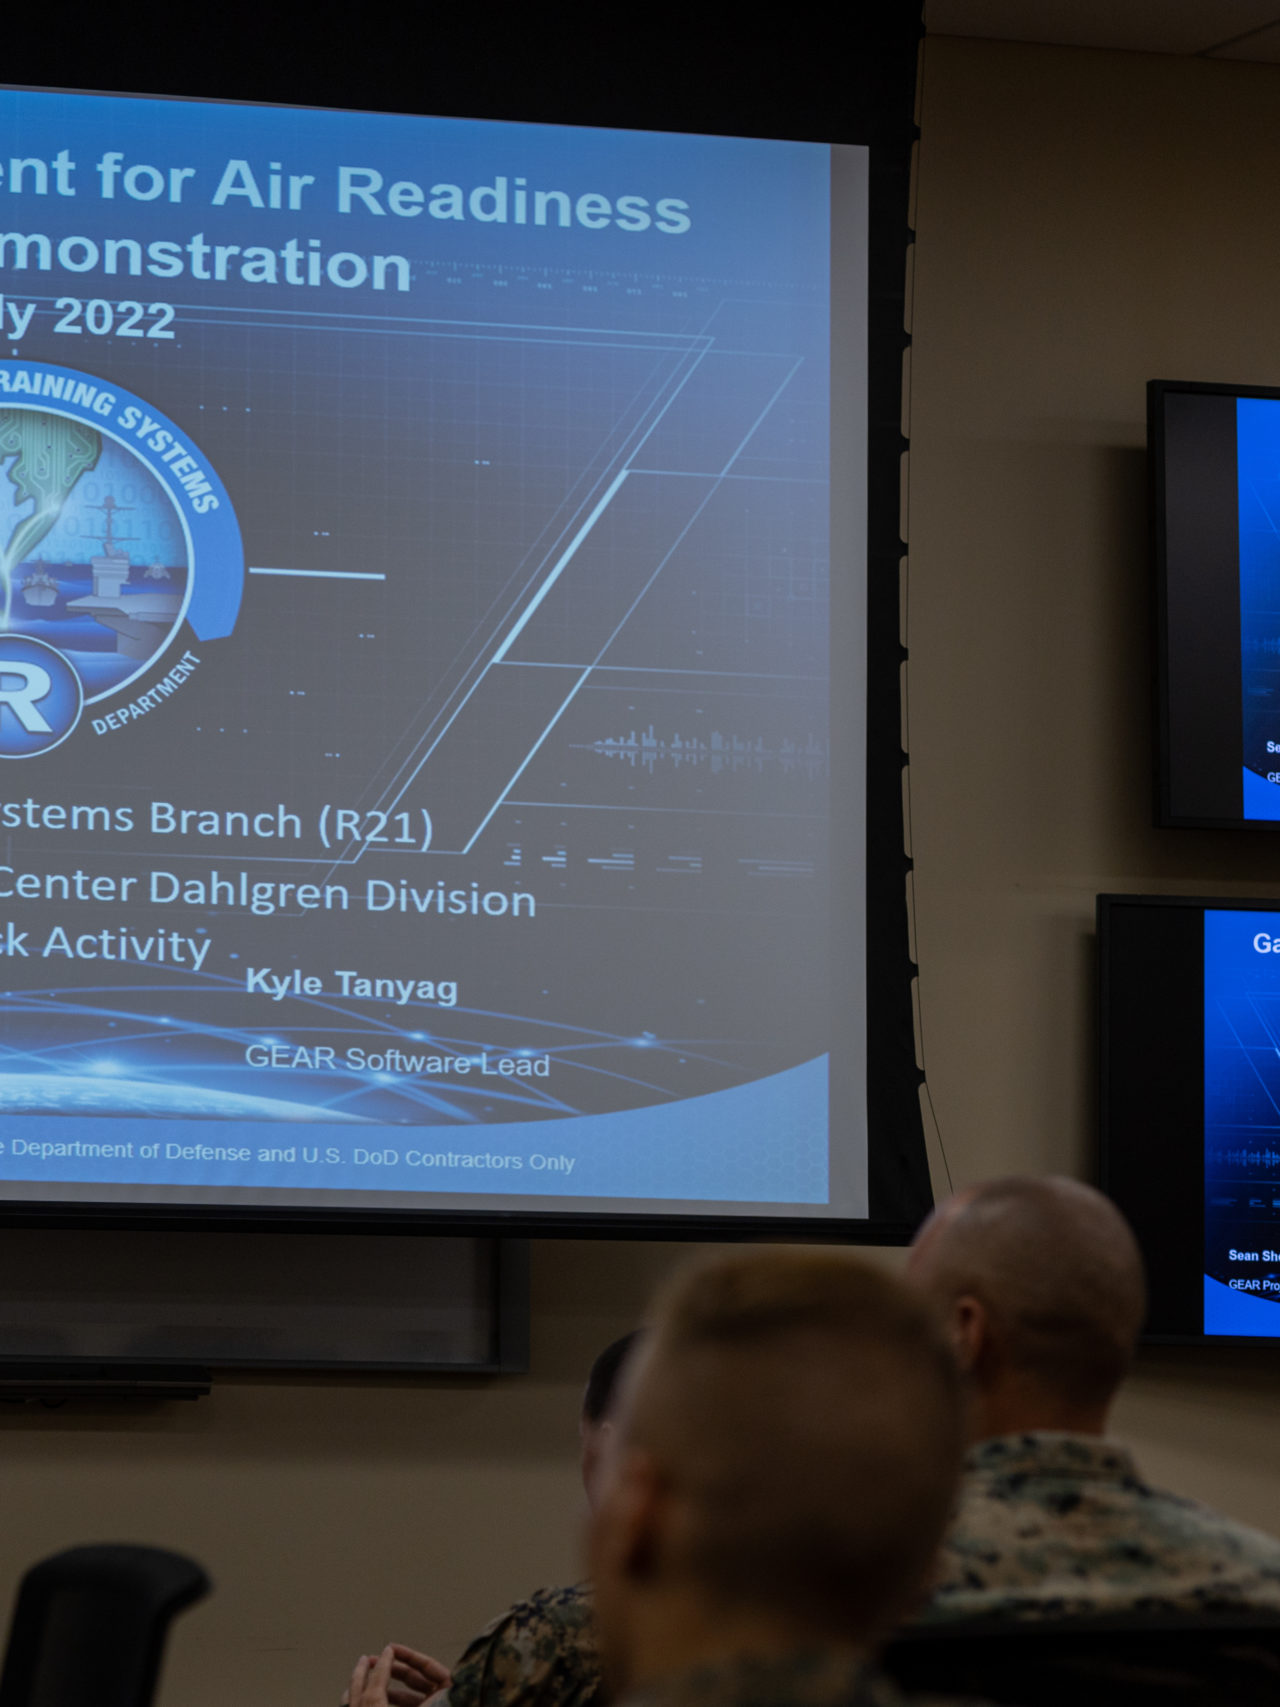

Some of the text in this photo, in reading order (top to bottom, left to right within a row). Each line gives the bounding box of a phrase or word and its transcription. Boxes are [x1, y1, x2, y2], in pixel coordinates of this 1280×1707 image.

[96, 151, 196, 203] for
[211, 159, 315, 210] Air
[336, 166, 692, 234] Readiness
[53, 297, 175, 340] 2022
[117, 406, 220, 515] SYSTEMS
[91, 650, 201, 736] DEPARTMENT
[151, 802, 301, 838] Branch
[319, 804, 433, 853] (R21)
[150, 871, 349, 916] Dahlgren
[366, 879, 536, 917] Division
[42, 926, 212, 971] Activity
[246, 967, 458, 1007] Kyle Tanyag
[245, 1044, 550, 1078] GEAR Software Lead
[11, 1138, 134, 1163] Department
[139, 1142, 160, 1160] of
[166, 1143, 251, 1163] Defense
[257, 1144, 296, 1163] and
[302, 1147, 345, 1165] U.S.
[354, 1148, 399, 1167] DoD
[405, 1149, 523, 1170] Contractors
[529, 1153, 576, 1175] Only
[1229, 1249, 1259, 1261] Sean
[1229, 1279, 1261, 1290] GEAR
